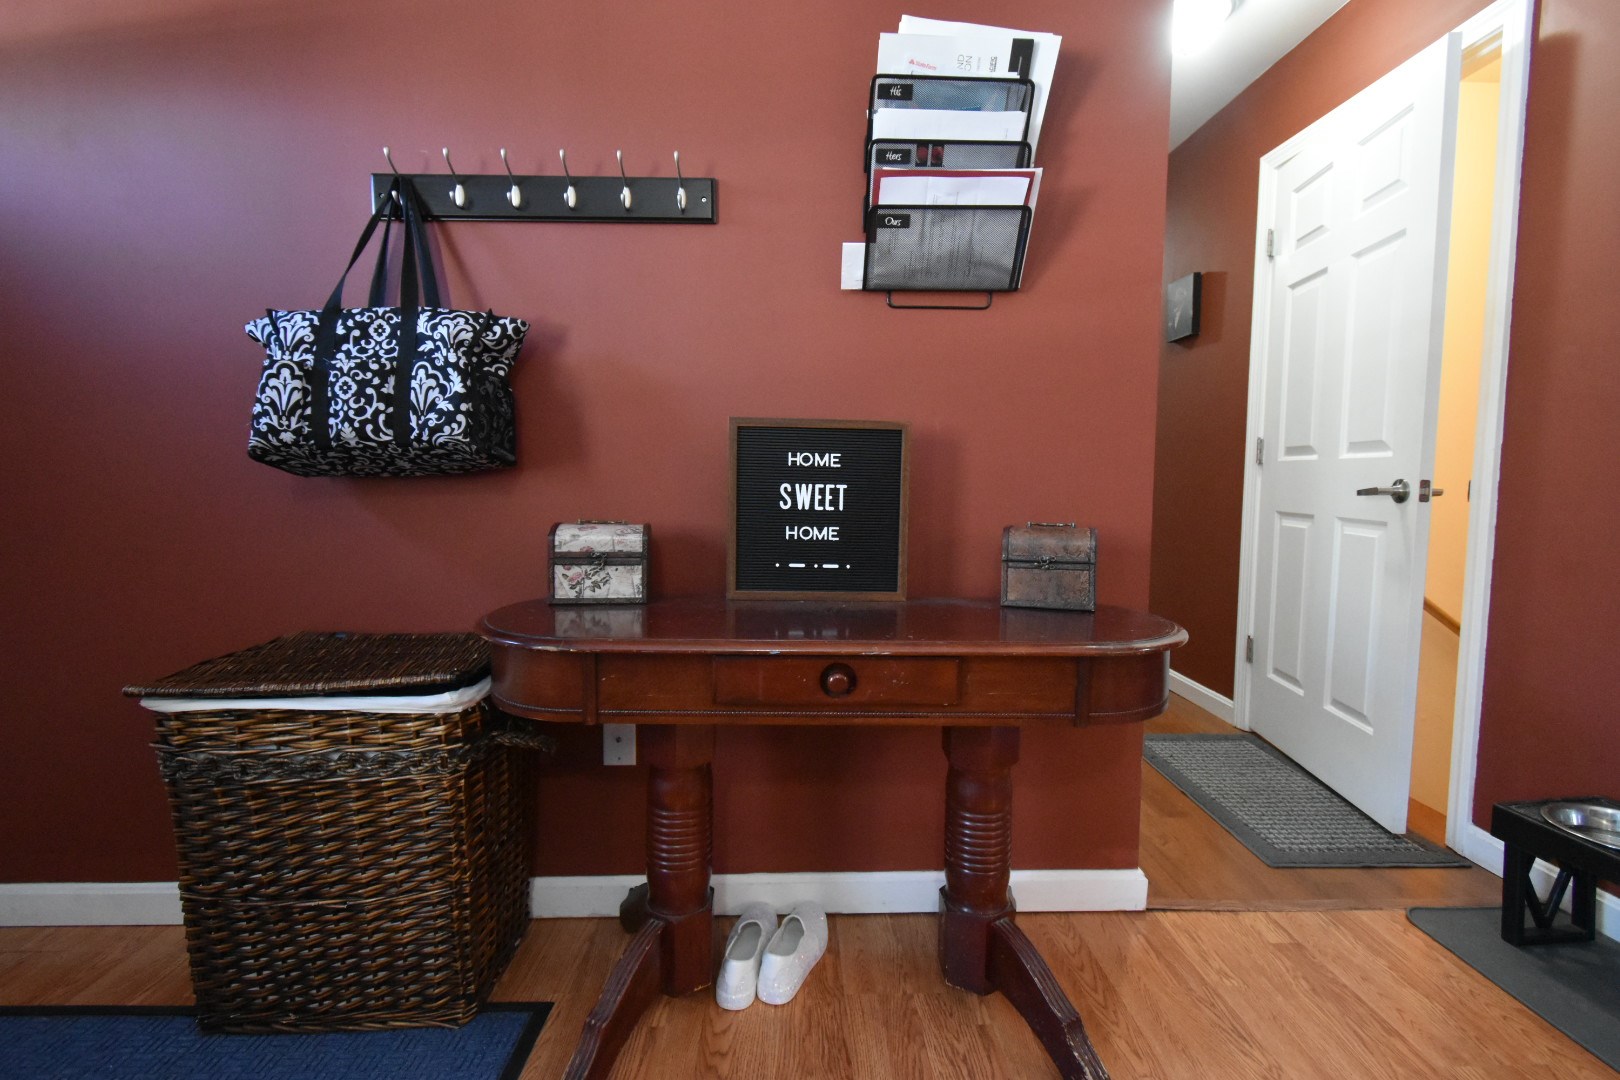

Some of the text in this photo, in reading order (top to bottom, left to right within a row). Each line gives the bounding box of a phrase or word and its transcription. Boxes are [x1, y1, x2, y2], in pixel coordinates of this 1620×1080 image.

[889, 85, 902, 97] His
[885, 151, 903, 161] Hers
[884, 216, 902, 227] Ours
[788, 452, 842, 467] HOME
[779, 483, 848, 511] SWEET
[785, 525, 840, 541] HOME
